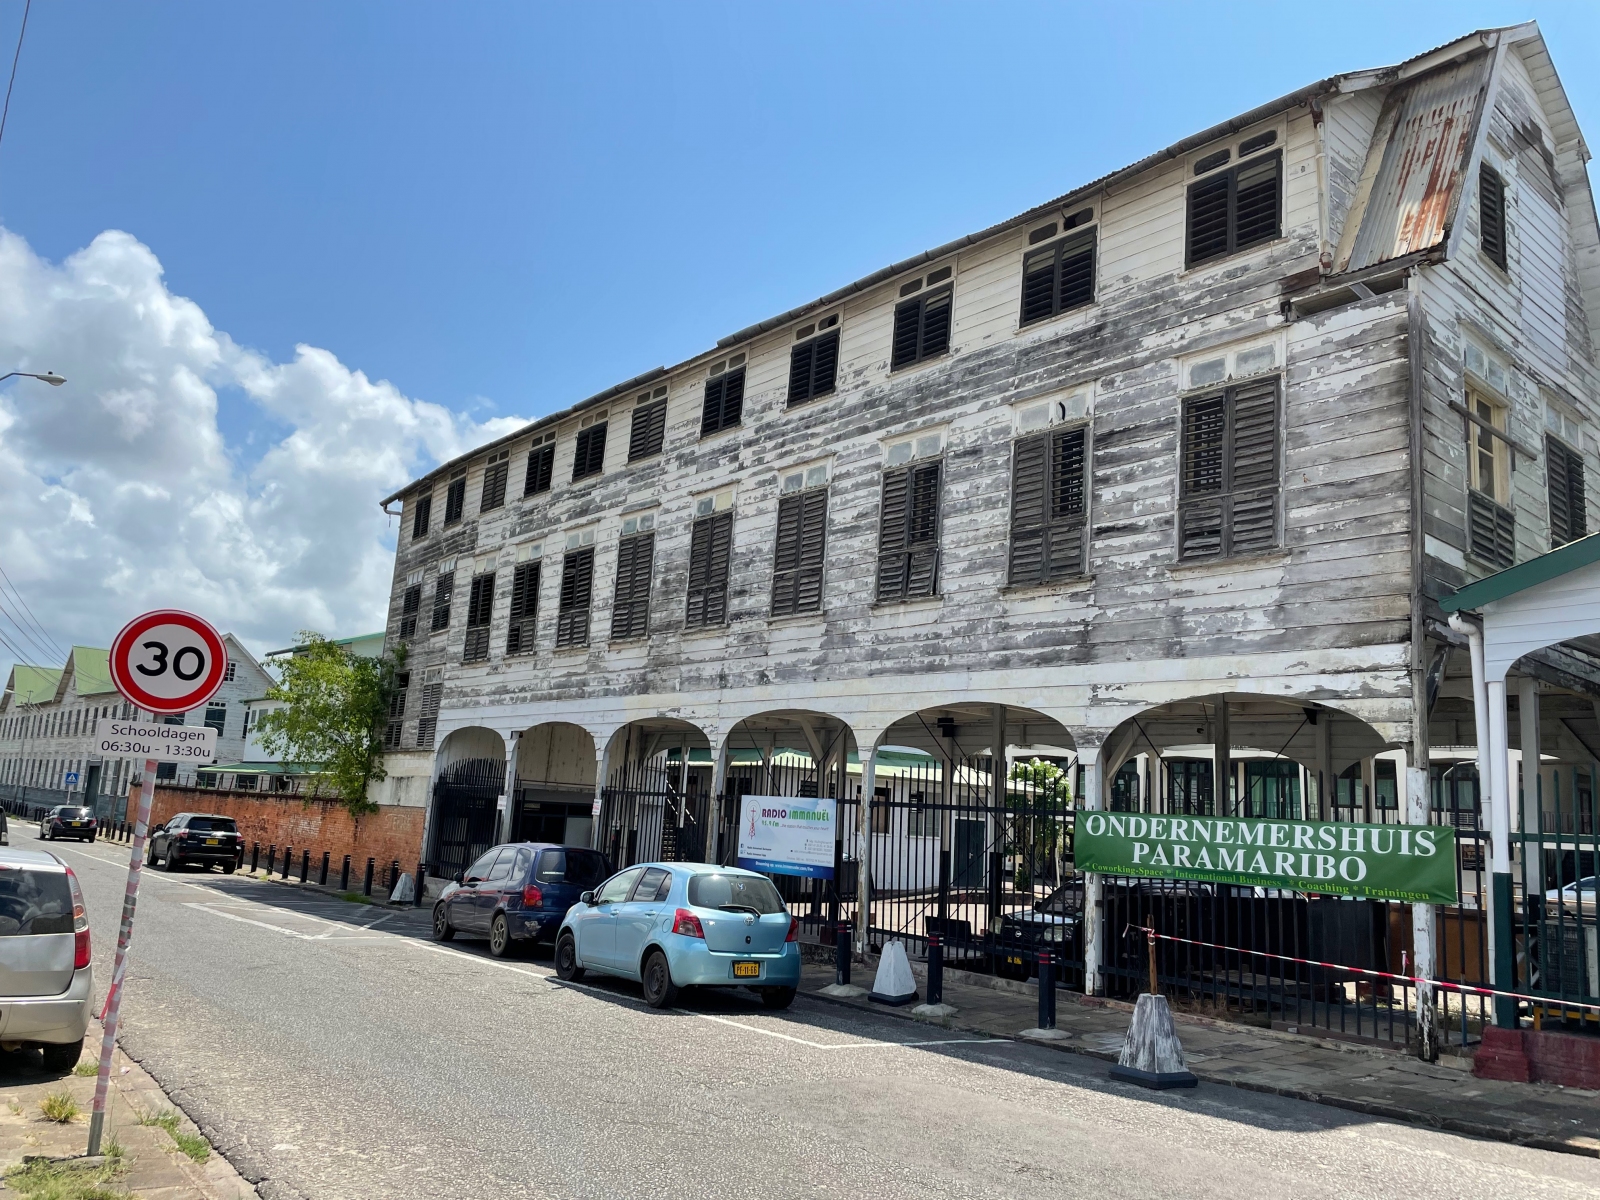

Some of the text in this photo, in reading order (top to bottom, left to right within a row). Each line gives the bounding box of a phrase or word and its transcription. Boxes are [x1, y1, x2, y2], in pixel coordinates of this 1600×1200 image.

[135, 641, 205, 681] 30
[101, 740, 150, 754] 06:30u
[165, 744, 211, 758] 13:30u
[111, 724, 206, 742] Schooldagen
[762, 809, 829, 821] RADIO IMMANUËL
[1085, 814, 1437, 857] ONDERNEMERSHUIS
[1131, 841, 1368, 882] PARAMARIBO
[1092, 863, 1430, 900] Coworking-Space International Business Coaching Trainingen
